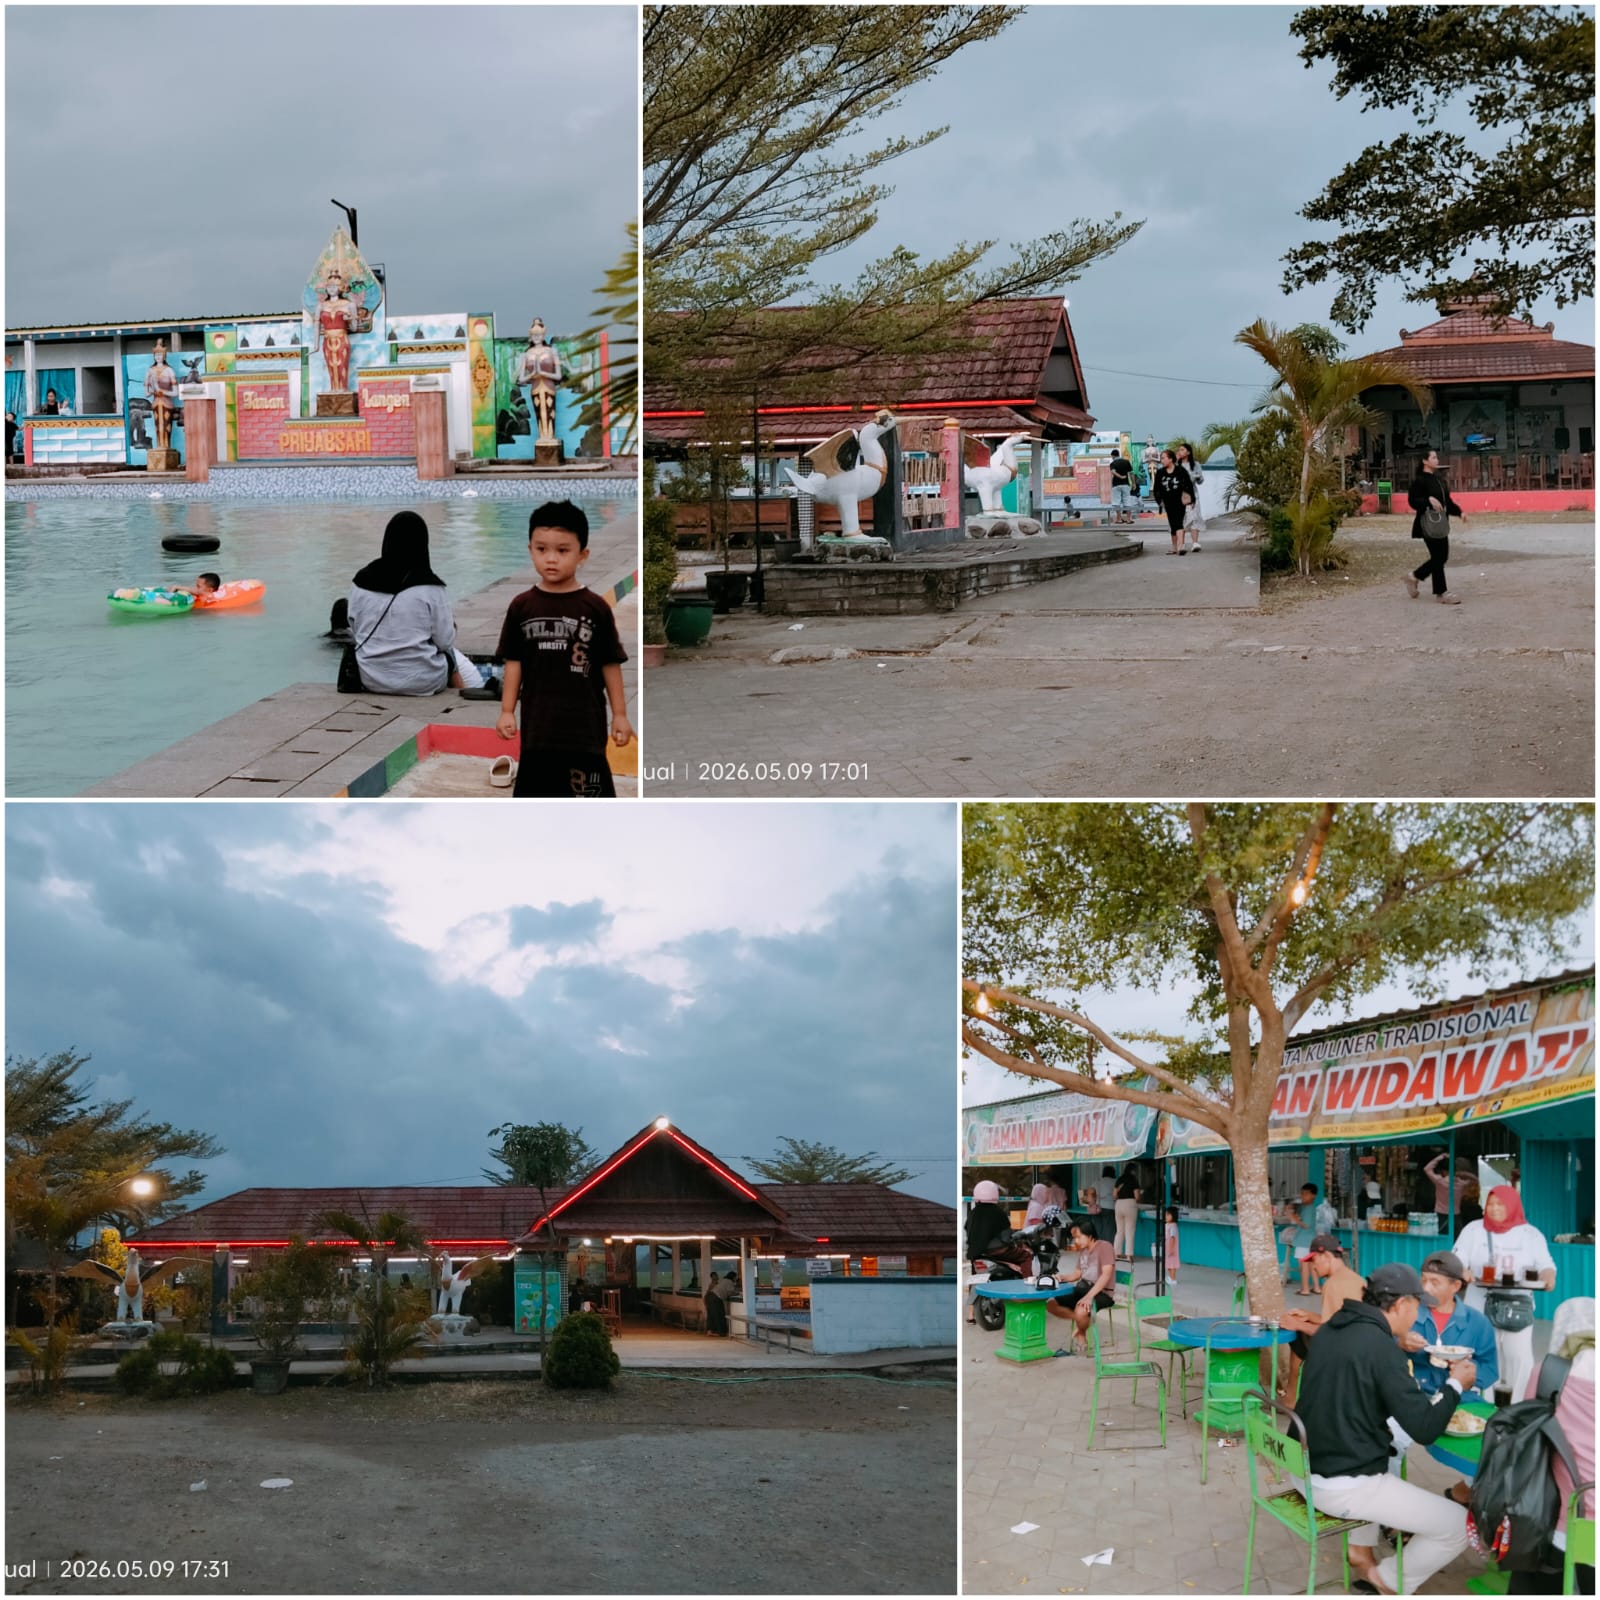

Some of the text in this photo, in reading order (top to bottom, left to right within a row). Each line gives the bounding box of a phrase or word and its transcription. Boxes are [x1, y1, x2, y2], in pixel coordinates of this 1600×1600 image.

[362, 388, 410, 413] Langen
[279, 431, 371, 453] PRIYABSARI
[1284, 1002, 1531, 1067] TA KULINER TRADISIONAL
[1270, 1071, 1319, 1120] AN
